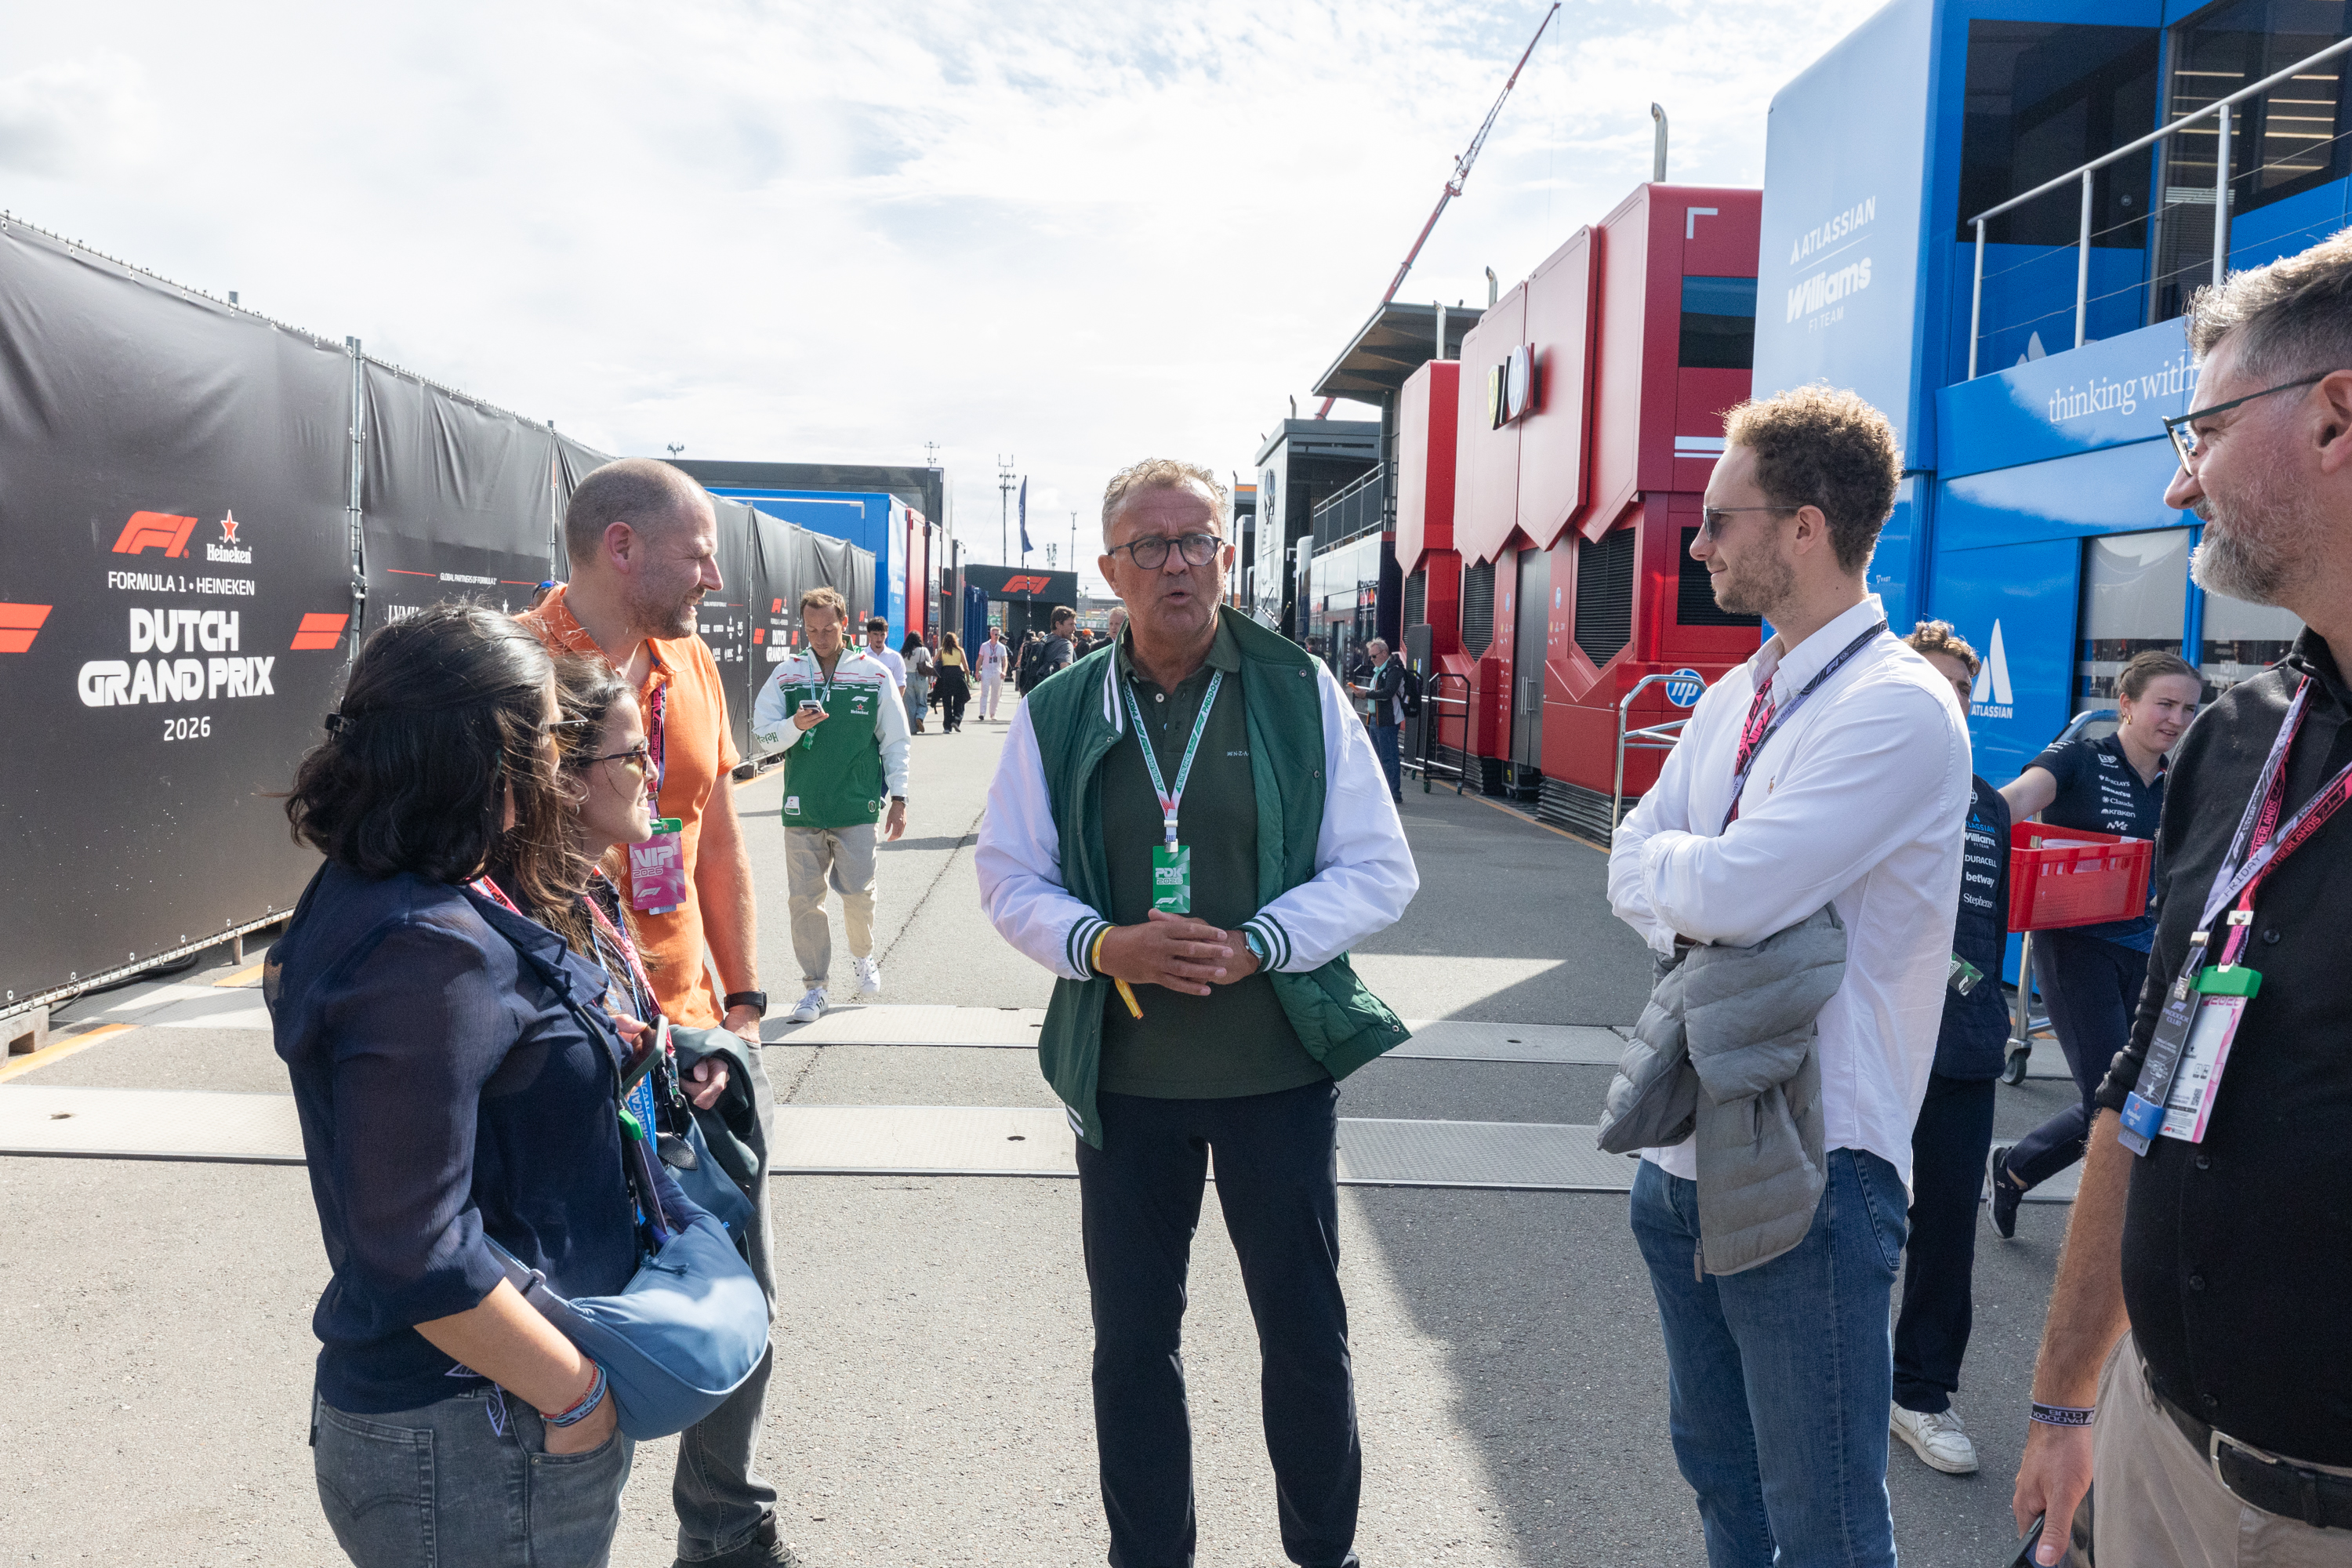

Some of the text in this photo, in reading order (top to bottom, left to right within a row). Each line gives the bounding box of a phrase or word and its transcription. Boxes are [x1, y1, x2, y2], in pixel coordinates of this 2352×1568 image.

[1801, 195, 1875, 259] ATLASSIAN
[1787, 257, 1872, 324] Williams
[1809, 306, 1844, 334] F1 TEAM
[2049, 355, 2194, 423] thinking with
[206, 543, 252, 564] Heineken
[108, 572, 176, 592] FORMULA
[196, 577, 255, 596] HEINEKEN
[440, 572, 454, 582] GLOBAL
[455, 574, 472, 583] PARTNERS
[129, 608, 239, 653] DUTCH
[772, 630, 786, 645] DUTCH
[78, 656, 275, 707] GRAND PRIX
[1970, 705, 2013, 720] ATLASSIAN
[164, 717, 211, 741] 2026
[1177, 753, 1192, 789] NETHERLANDS
[1202, 674, 1221, 713] PADDOCK
[1147, 753, 1163, 789] NETHERLANDS
[2104, 776, 2130, 786] BARCLAYS
[2110, 797, 2134, 808] Claude
[2109, 808, 2136, 818] kraken
[1965, 821, 1995, 833] TLASSIAN
[2252, 798, 2278, 852] THERLANDS
[633, 845, 674, 868] VIP
[1965, 855, 1997, 867] DURACELL
[633, 866, 663, 878] 2026
[1155, 867, 1183, 877] PDK
[1965, 871, 1994, 887] betway
[2223, 854, 2261, 898] FRIDAY
[1963, 892, 1993, 908] Stephens
[2162, 1007, 2190, 1023] PADDOCK
[2166, 1016, 2182, 1027] CLUB
[2033, 1410, 2083, 1424] PADDOCK
[2049, 1409, 2083, 1418] CLUB
